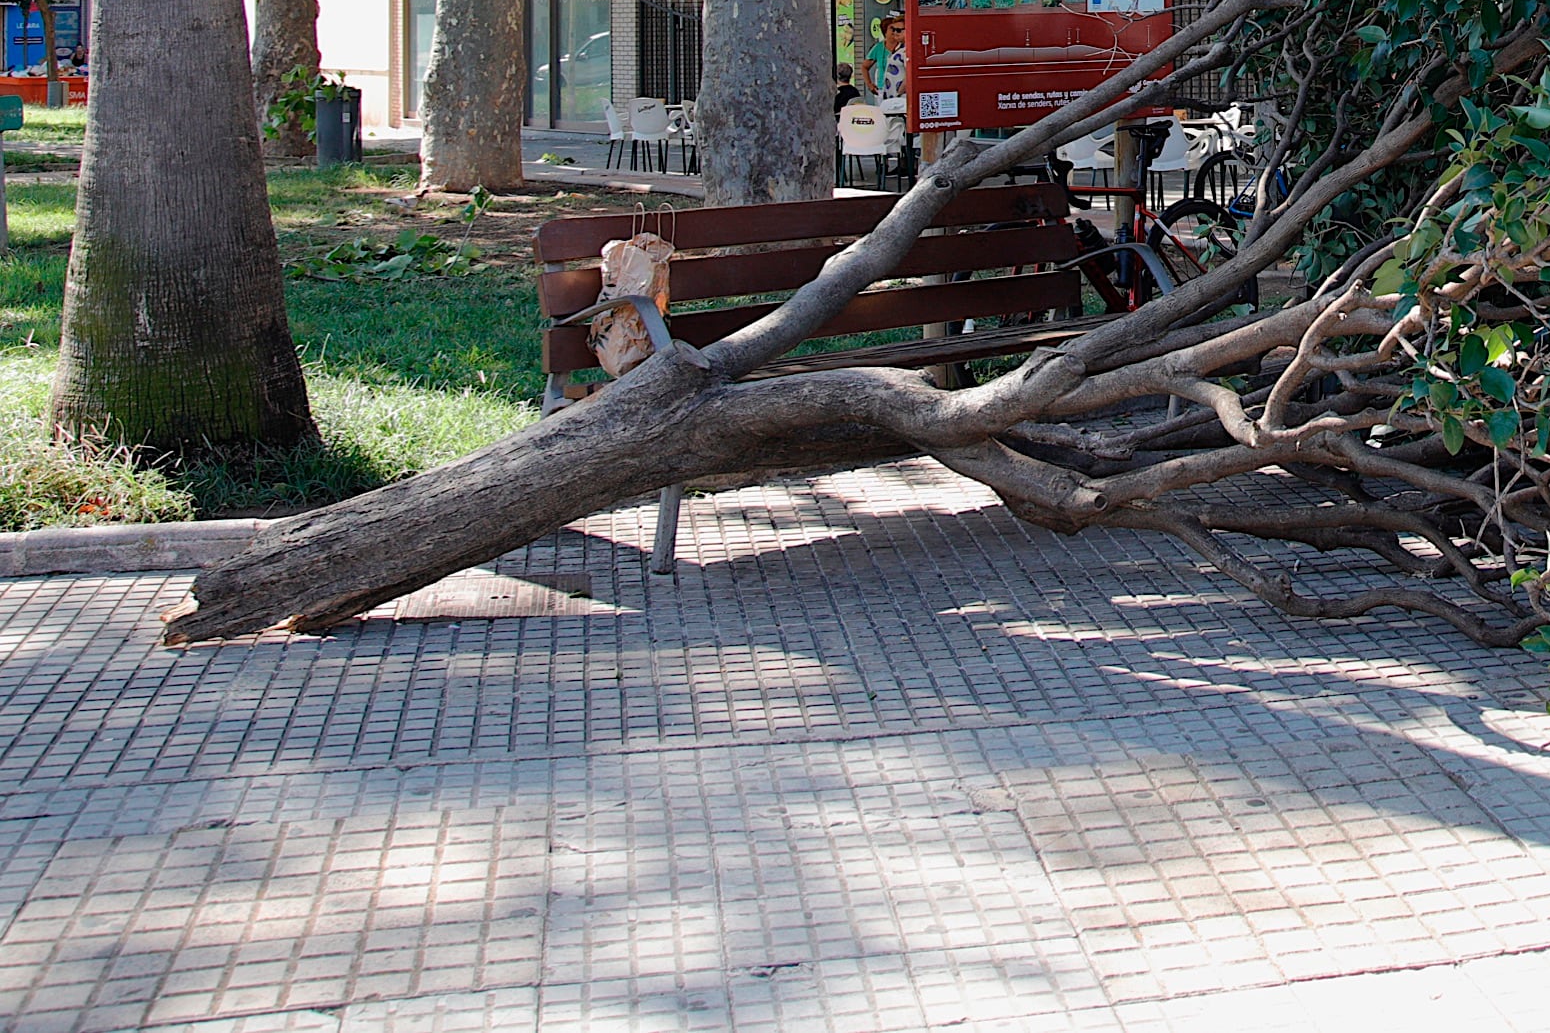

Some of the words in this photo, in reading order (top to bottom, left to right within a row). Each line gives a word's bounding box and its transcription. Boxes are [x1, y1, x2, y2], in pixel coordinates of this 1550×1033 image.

[998, 93, 1011, 101] Red
[1012, 92, 1020, 100] de
[1017, 100, 1026, 108] de
